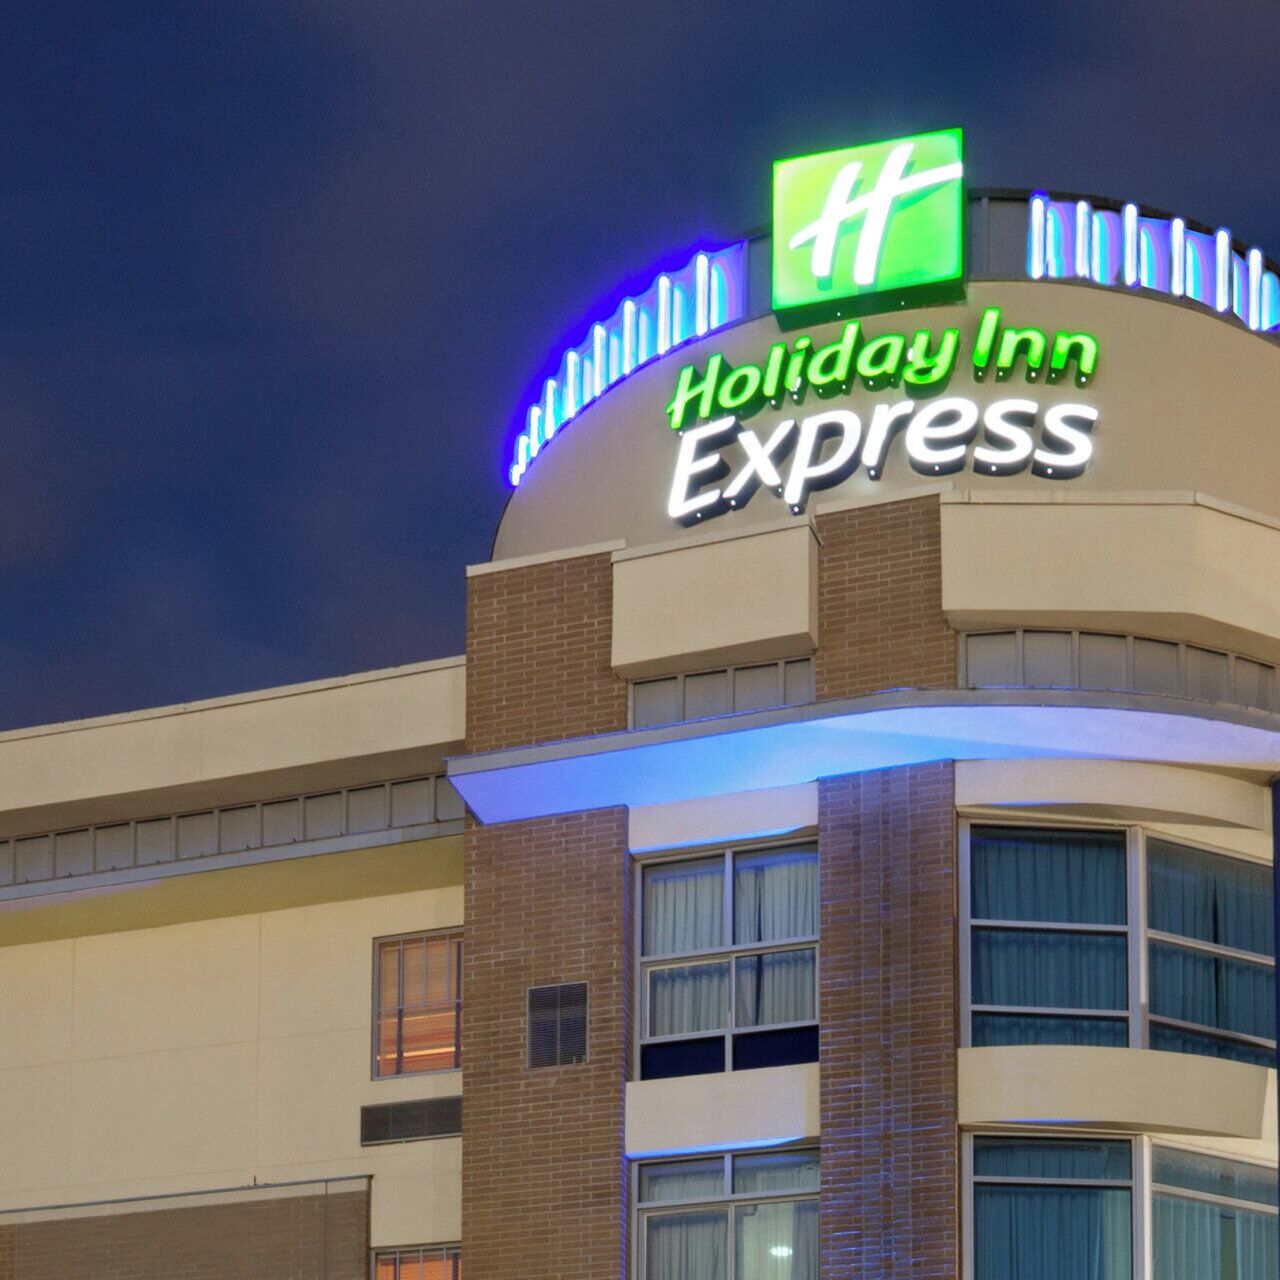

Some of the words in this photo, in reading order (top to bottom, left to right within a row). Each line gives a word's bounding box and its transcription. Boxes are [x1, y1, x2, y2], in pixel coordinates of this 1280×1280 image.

[788, 142, 963, 285] H
[666, 320, 960, 430] Holiday
[972, 307, 1099, 376] Inn
[667, 397, 1099, 518] Express
